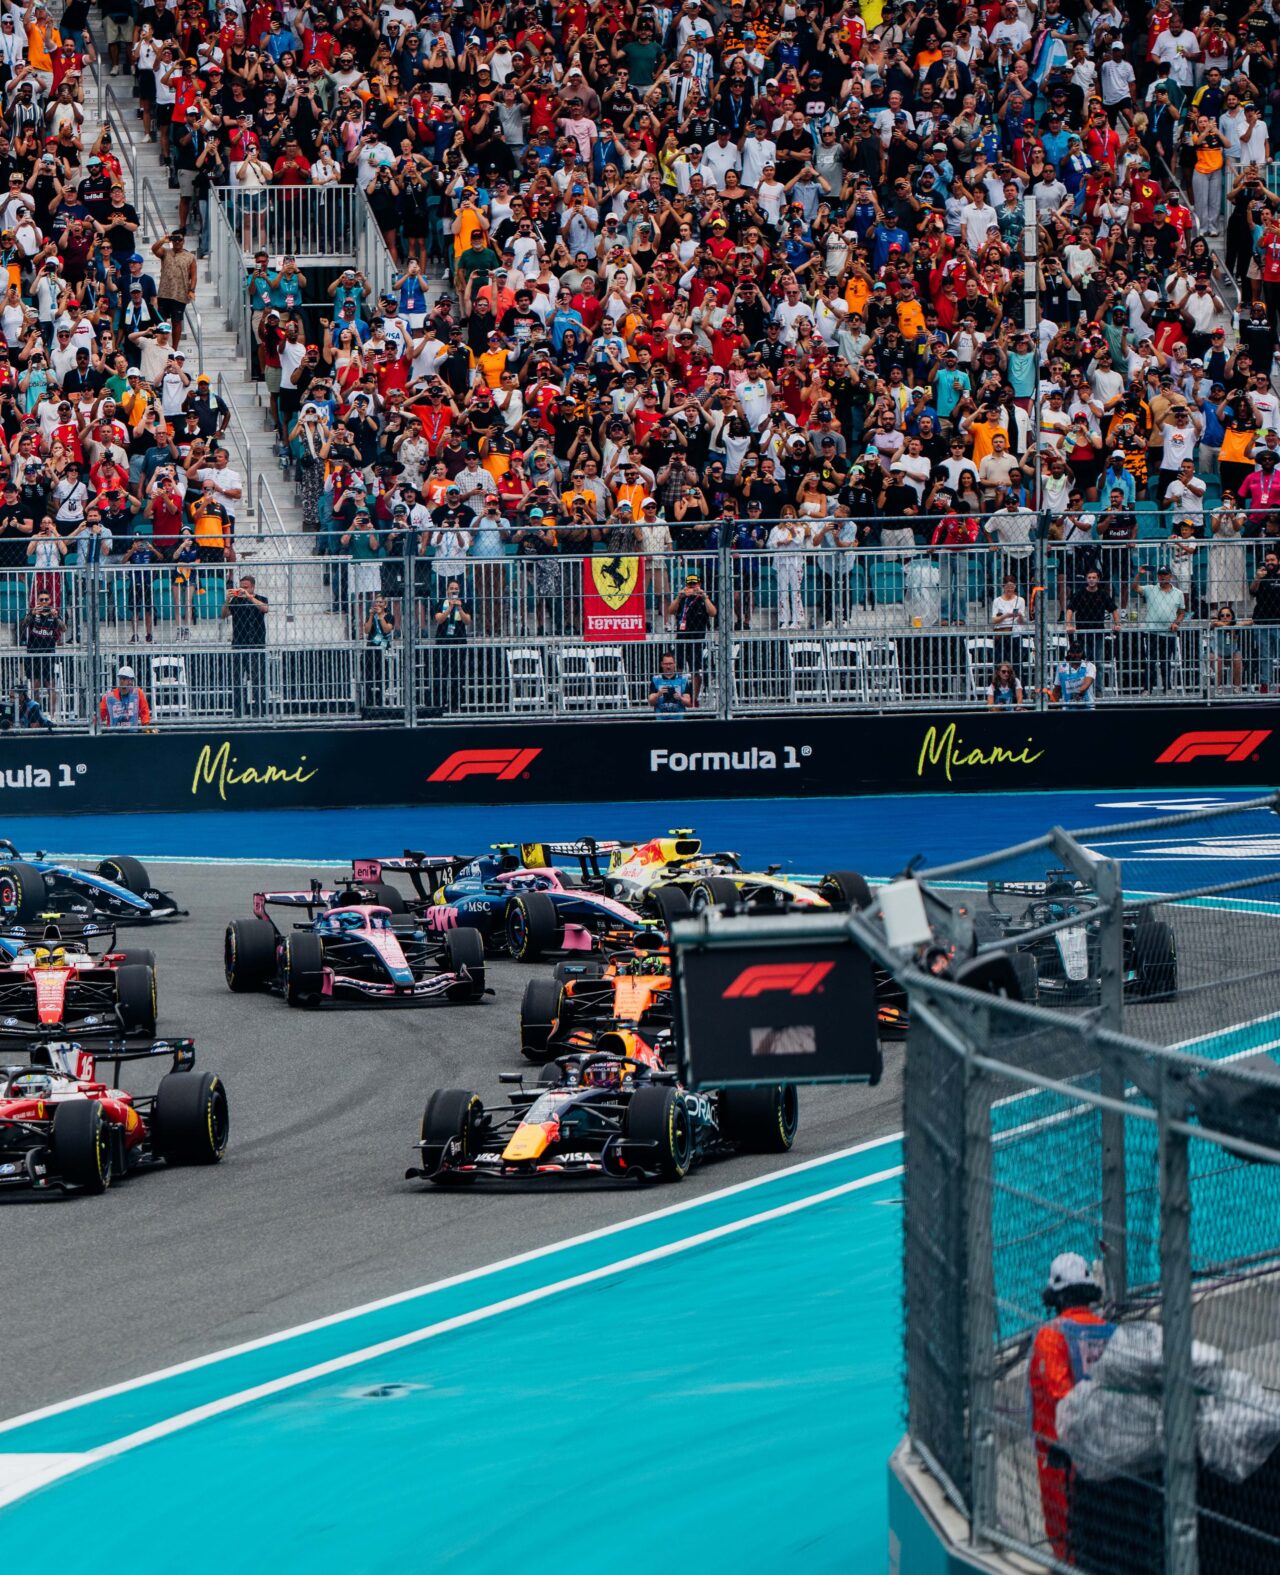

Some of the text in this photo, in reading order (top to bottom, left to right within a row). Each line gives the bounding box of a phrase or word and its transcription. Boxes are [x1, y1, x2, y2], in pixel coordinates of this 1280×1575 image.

[587, 615, 643, 631] Ferrari
[918, 722, 1045, 782] Miami
[1154, 729, 1273, 763] F1
[191, 741, 319, 800] Miami
[425, 748, 543, 782] F1
[650, 747, 776, 772] Formula
[357, 866, 370, 876] eni
[442, 867, 453, 884] 43
[426, 906, 458, 931] BWT
[469, 901, 491, 912] MSC
[722, 961, 836, 998] F1
[81, 1054, 93, 1081] 16
[475, 1153, 501, 1162] VISA
[558, 1152, 594, 1161] VISA
